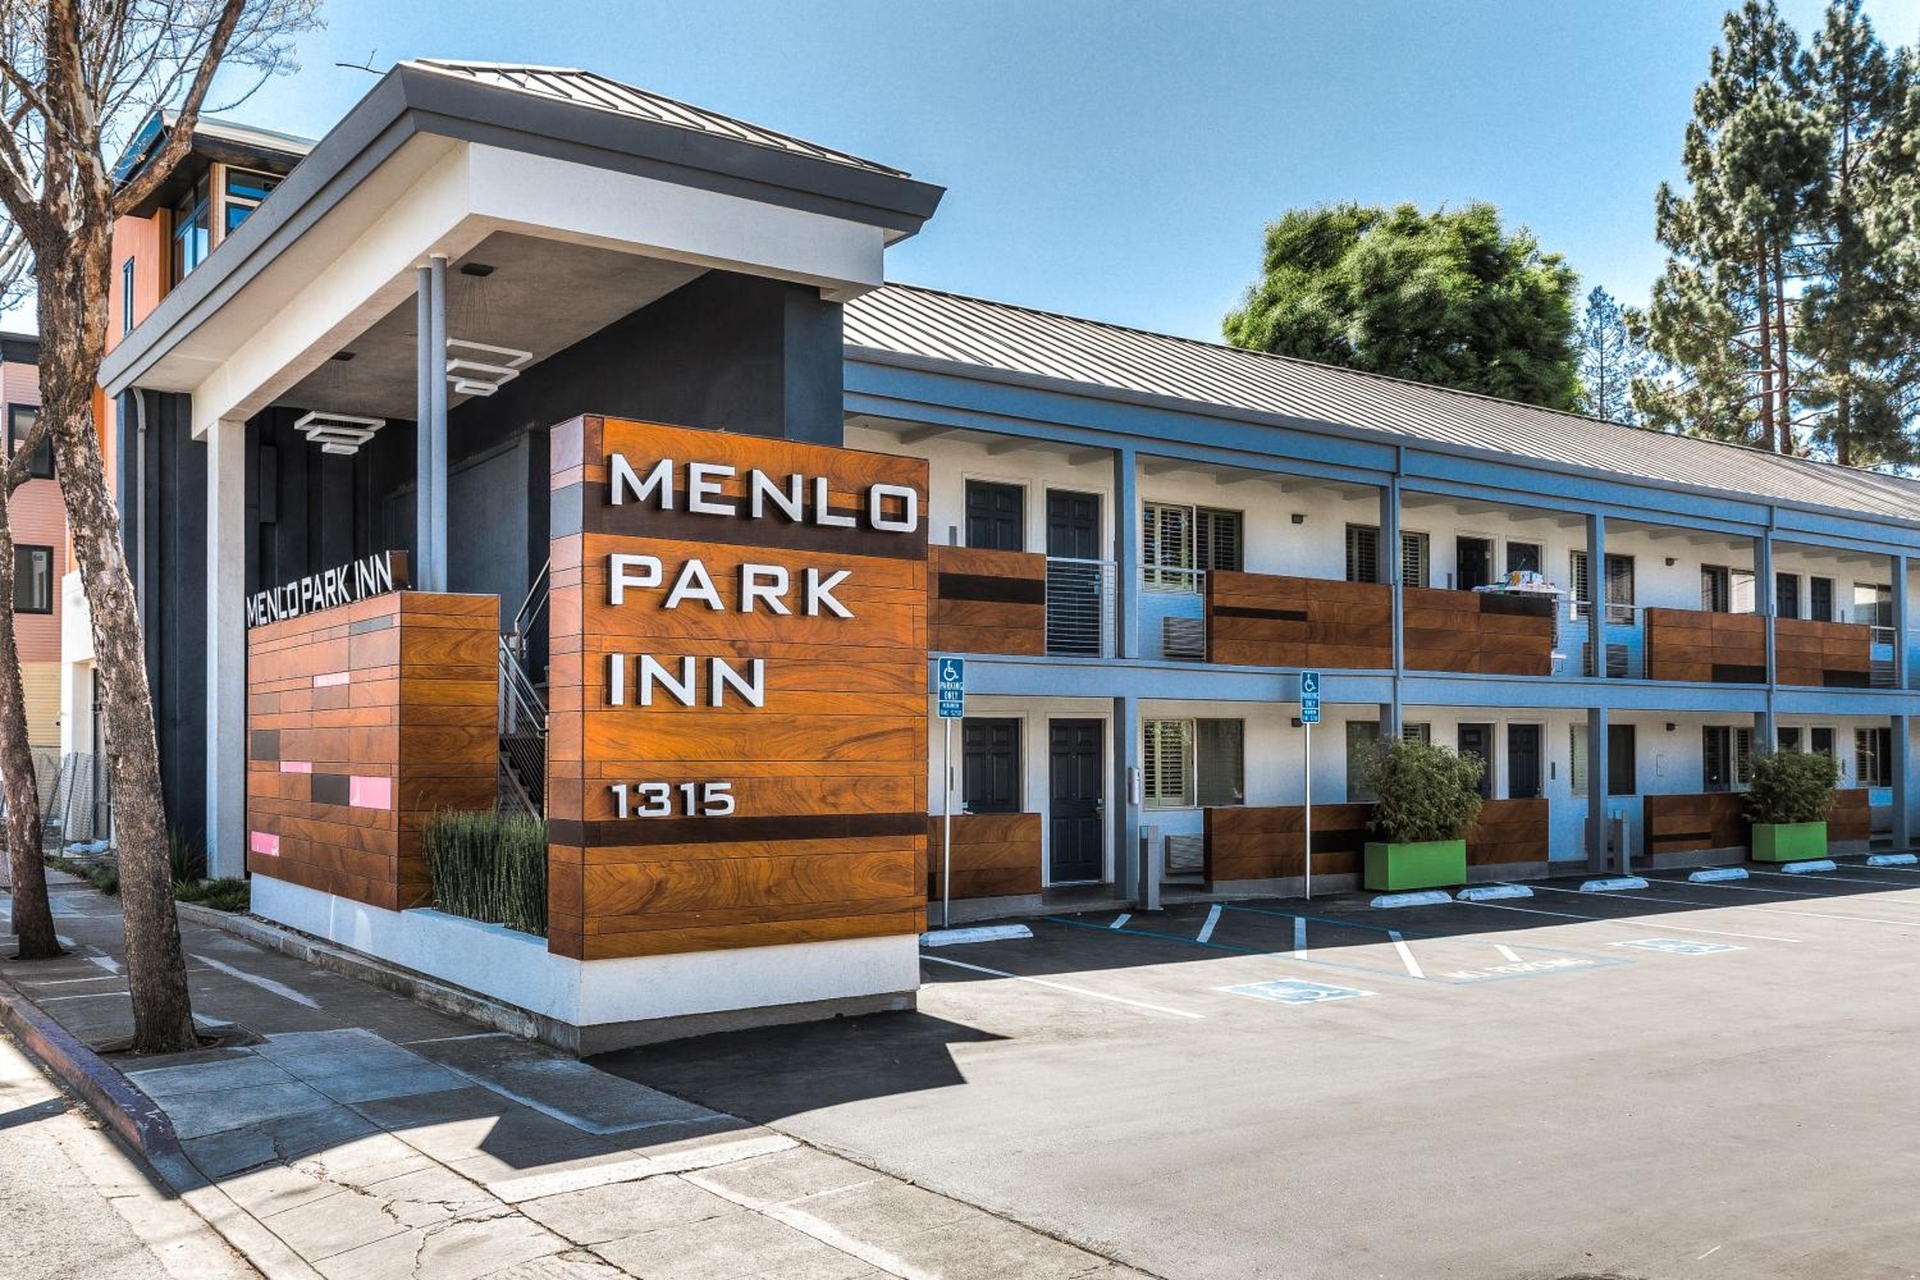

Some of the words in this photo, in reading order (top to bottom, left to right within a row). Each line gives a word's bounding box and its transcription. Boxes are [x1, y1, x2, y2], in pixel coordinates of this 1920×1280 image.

[609, 453, 918, 533] MENLO
[246, 581, 299, 628] MENLO
[302, 564, 352, 614] PARK
[354, 550, 393, 600] INN
[608, 553, 856, 618] PARK
[608, 653, 765, 707] INN
[609, 782, 736, 819] 1315
